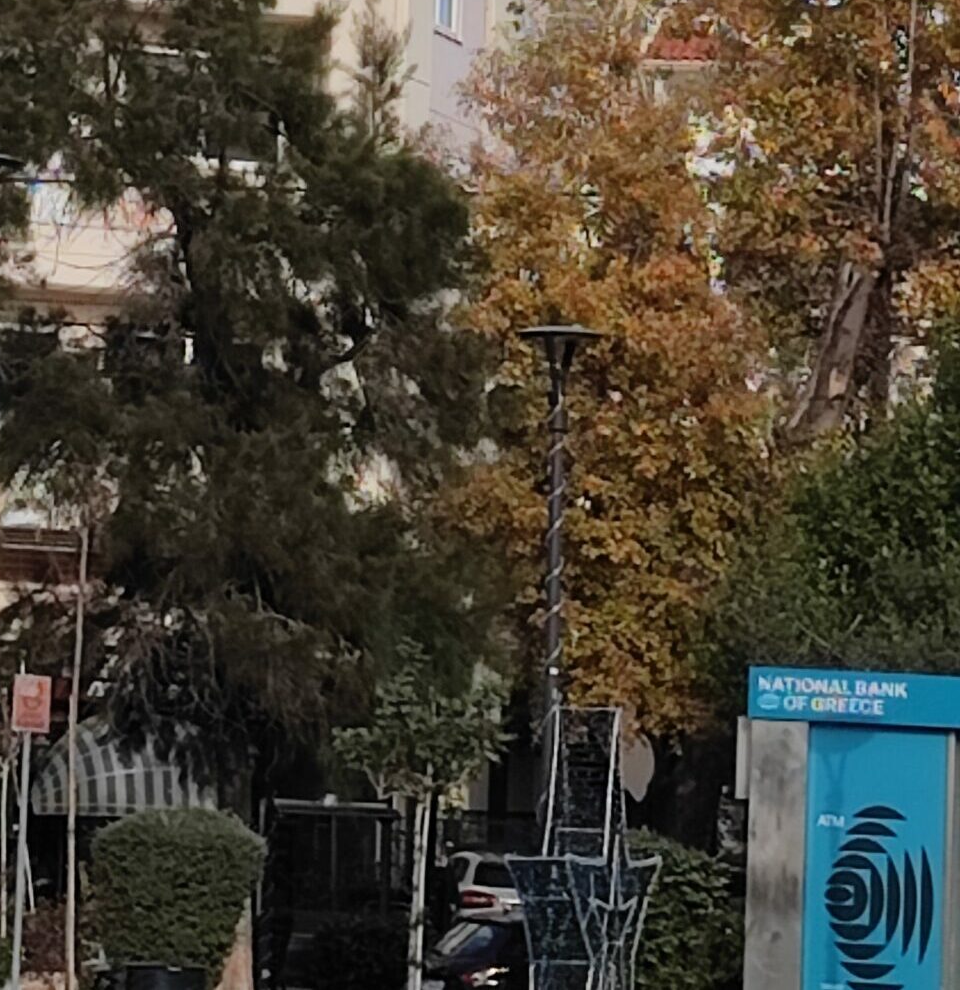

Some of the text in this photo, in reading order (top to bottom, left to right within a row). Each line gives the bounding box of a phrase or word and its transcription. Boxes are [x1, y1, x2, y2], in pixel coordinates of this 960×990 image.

[758, 675, 908, 698] NATIONAL BANK
[783, 695, 884, 715] OF GREECE
[816, 814, 845, 827] ATM
